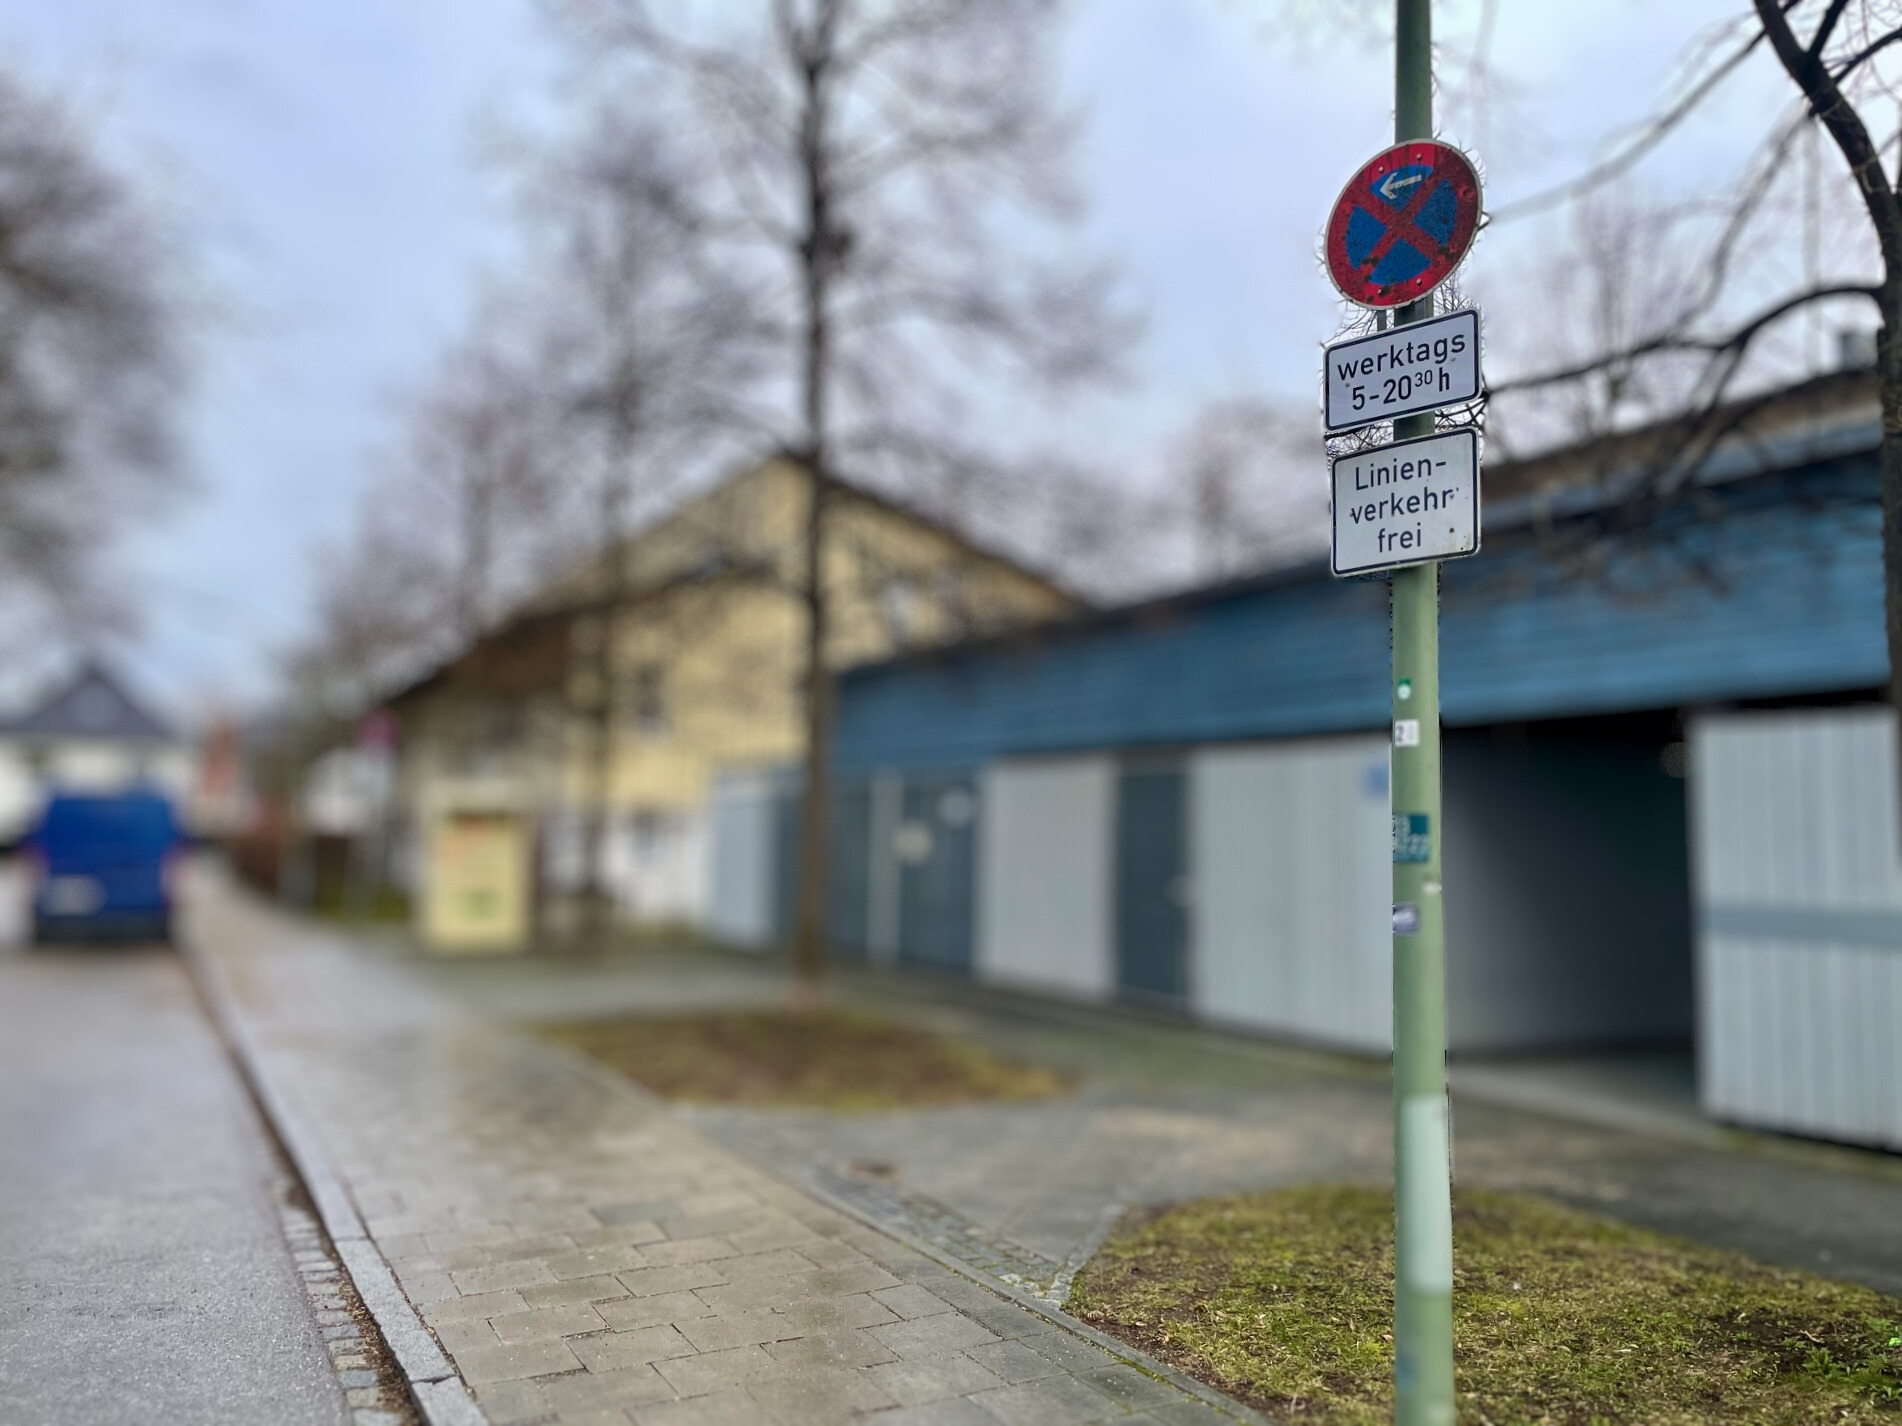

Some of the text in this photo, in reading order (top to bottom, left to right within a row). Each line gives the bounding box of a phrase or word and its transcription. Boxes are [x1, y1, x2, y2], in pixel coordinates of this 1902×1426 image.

[1337, 334, 1465, 381] werktags
[1355, 458, 1446, 491] Linien-
[1351, 486, 1453, 524] verkehr
[1377, 522, 1421, 553] frei
